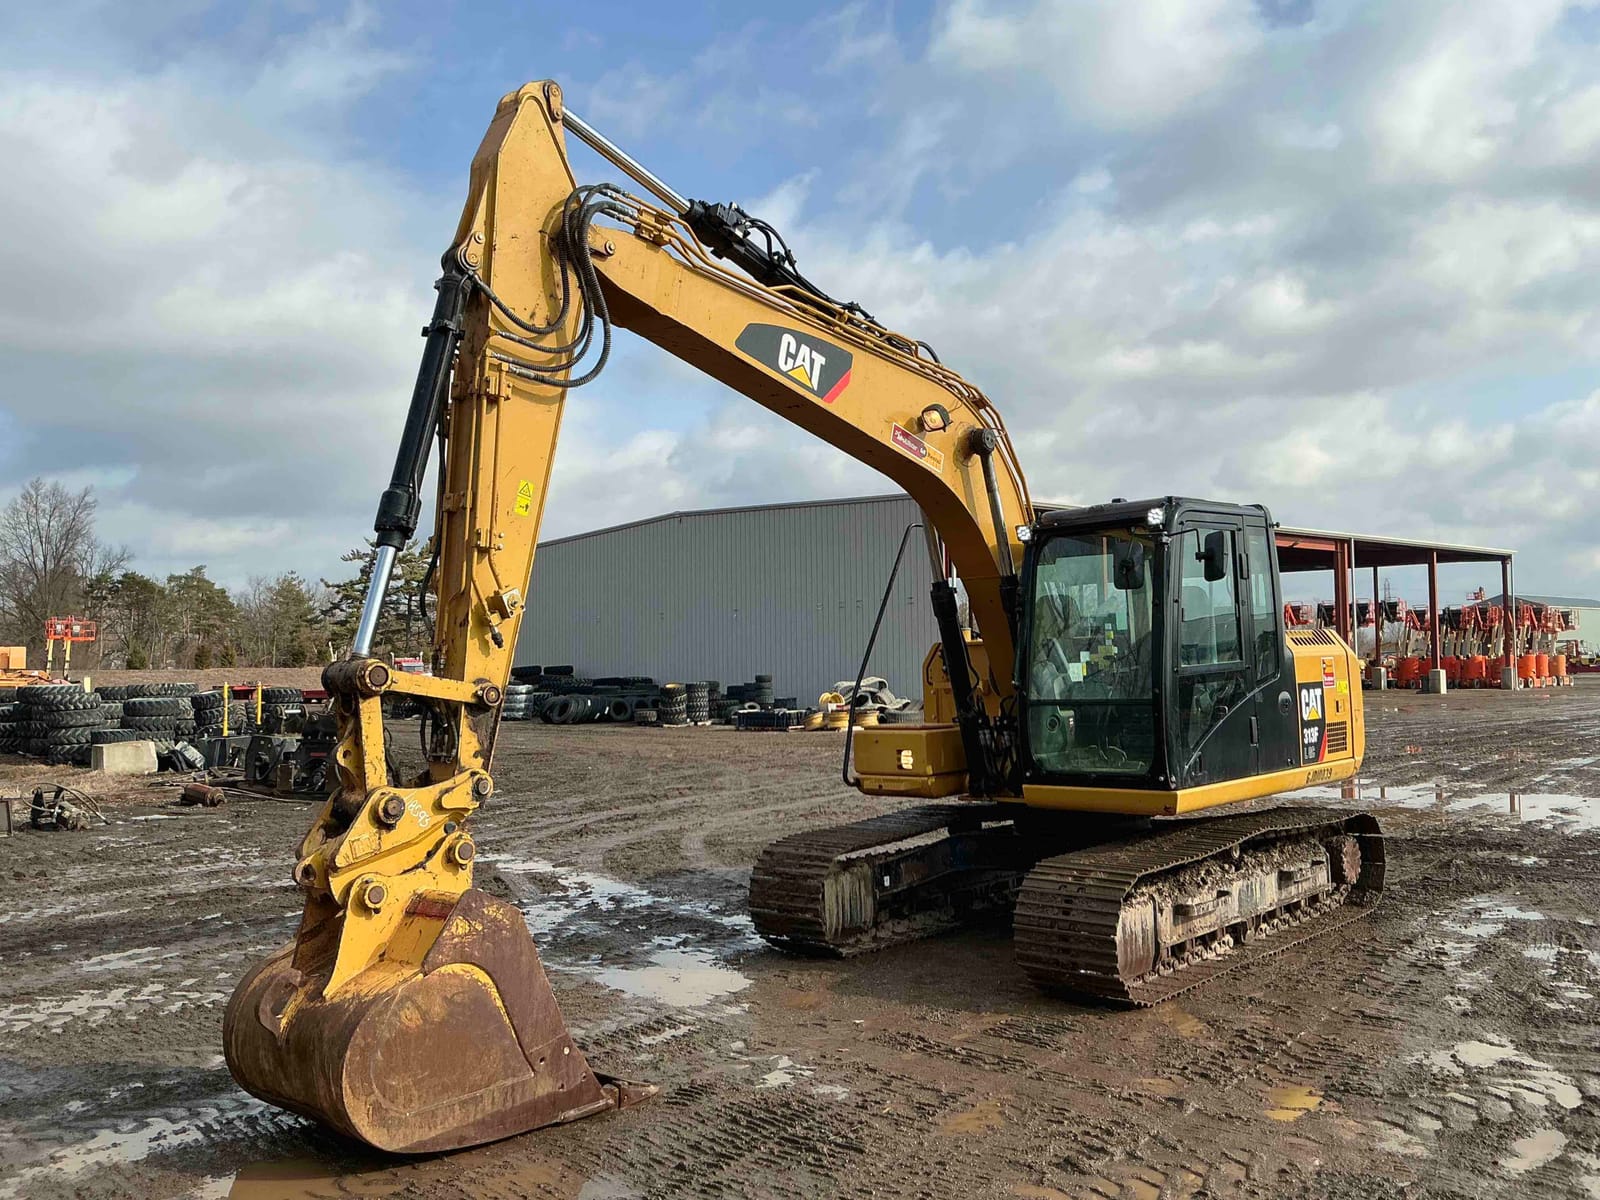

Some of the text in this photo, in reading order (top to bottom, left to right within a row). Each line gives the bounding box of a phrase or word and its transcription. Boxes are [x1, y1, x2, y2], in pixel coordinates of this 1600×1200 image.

[778, 333, 826, 392] CAT
[1300, 687, 1322, 720] CAT
[1303, 726, 1319, 745] 313F
